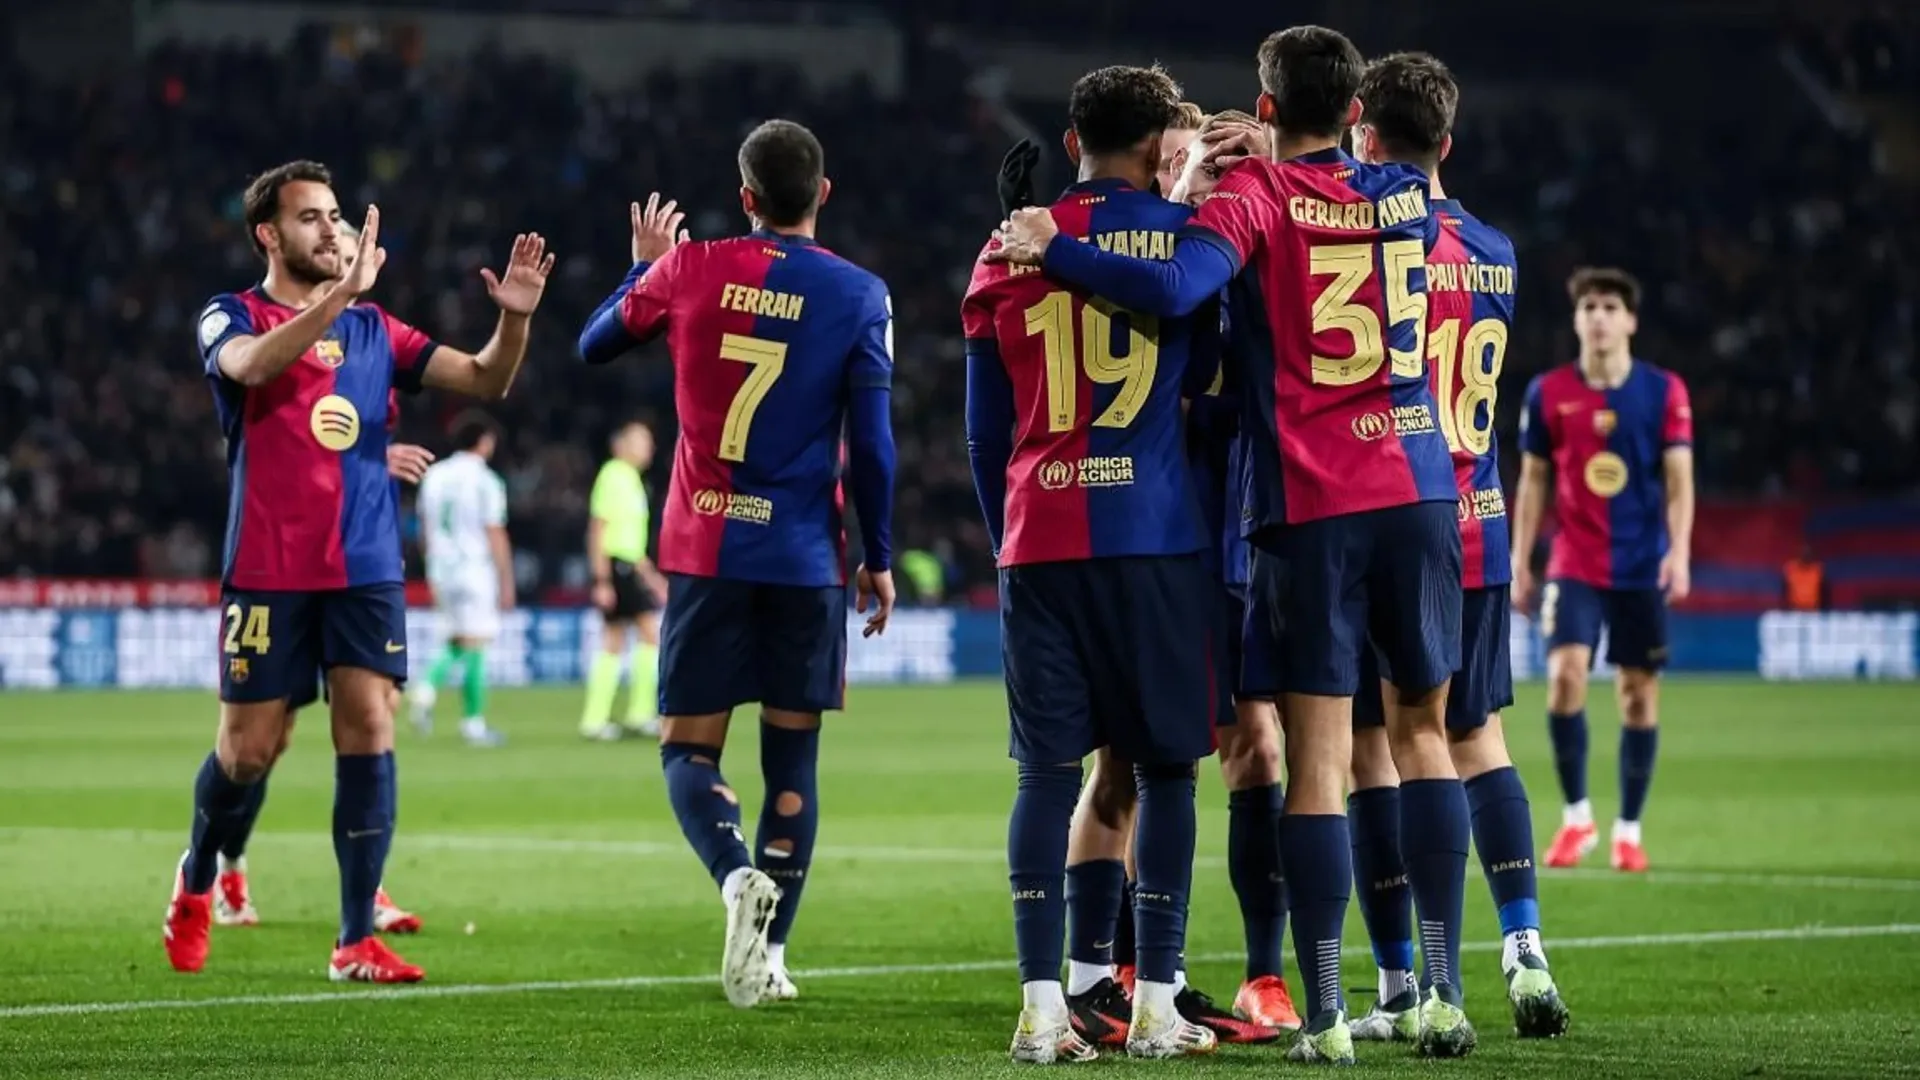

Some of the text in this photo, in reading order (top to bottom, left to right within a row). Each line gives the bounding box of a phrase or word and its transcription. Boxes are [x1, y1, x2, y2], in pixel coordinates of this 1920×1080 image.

[1289, 183, 1429, 231] GERARD MARÍN
[1425, 263, 1458, 292] PAU
[719, 282, 804, 322] FERRAN
[1309, 239, 1429, 387] 35
[1024, 290, 1160, 433] 19
[718, 332, 789, 462] 7
[1427, 318, 1508, 455] 18
[1394, 416, 1434, 431] ACNUR
[1077, 456, 1133, 470] UNHCR
[1077, 468, 1134, 482] ACNUR
[723, 505, 772, 522] ACNUR
[726, 493, 773, 510] UNHCR
[224, 603, 271, 655] 24
